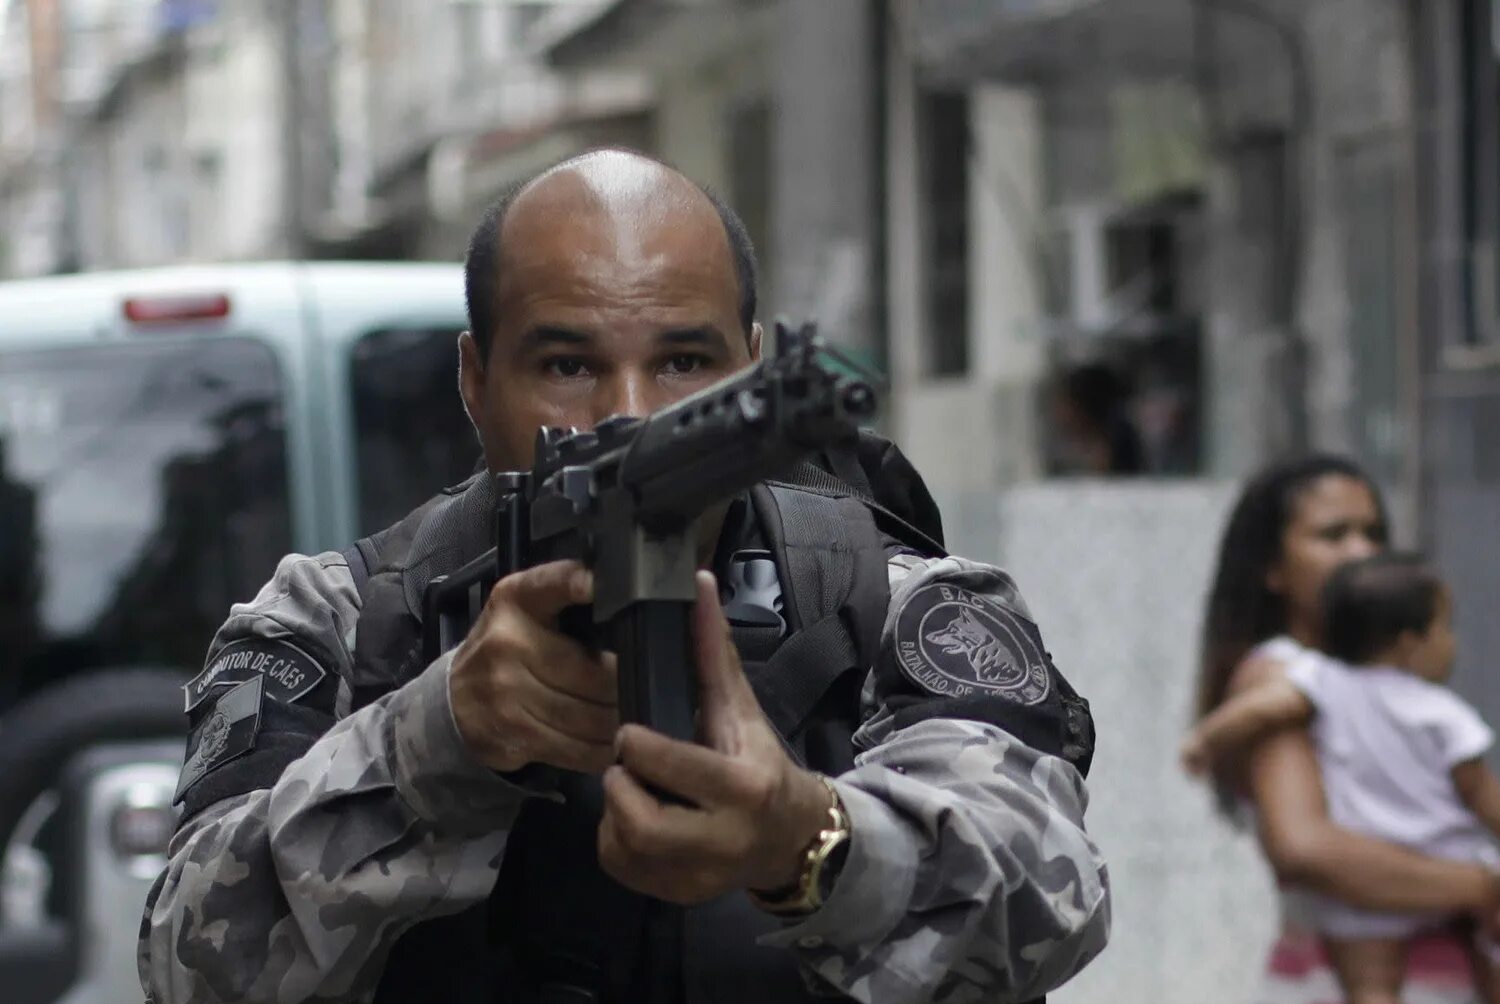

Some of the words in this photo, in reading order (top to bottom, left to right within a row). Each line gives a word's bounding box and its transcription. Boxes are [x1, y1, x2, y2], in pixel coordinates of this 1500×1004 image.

[939, 586, 985, 609] BAC
[250, 651, 275, 673] DE
[269, 659, 305, 689] CÃES
